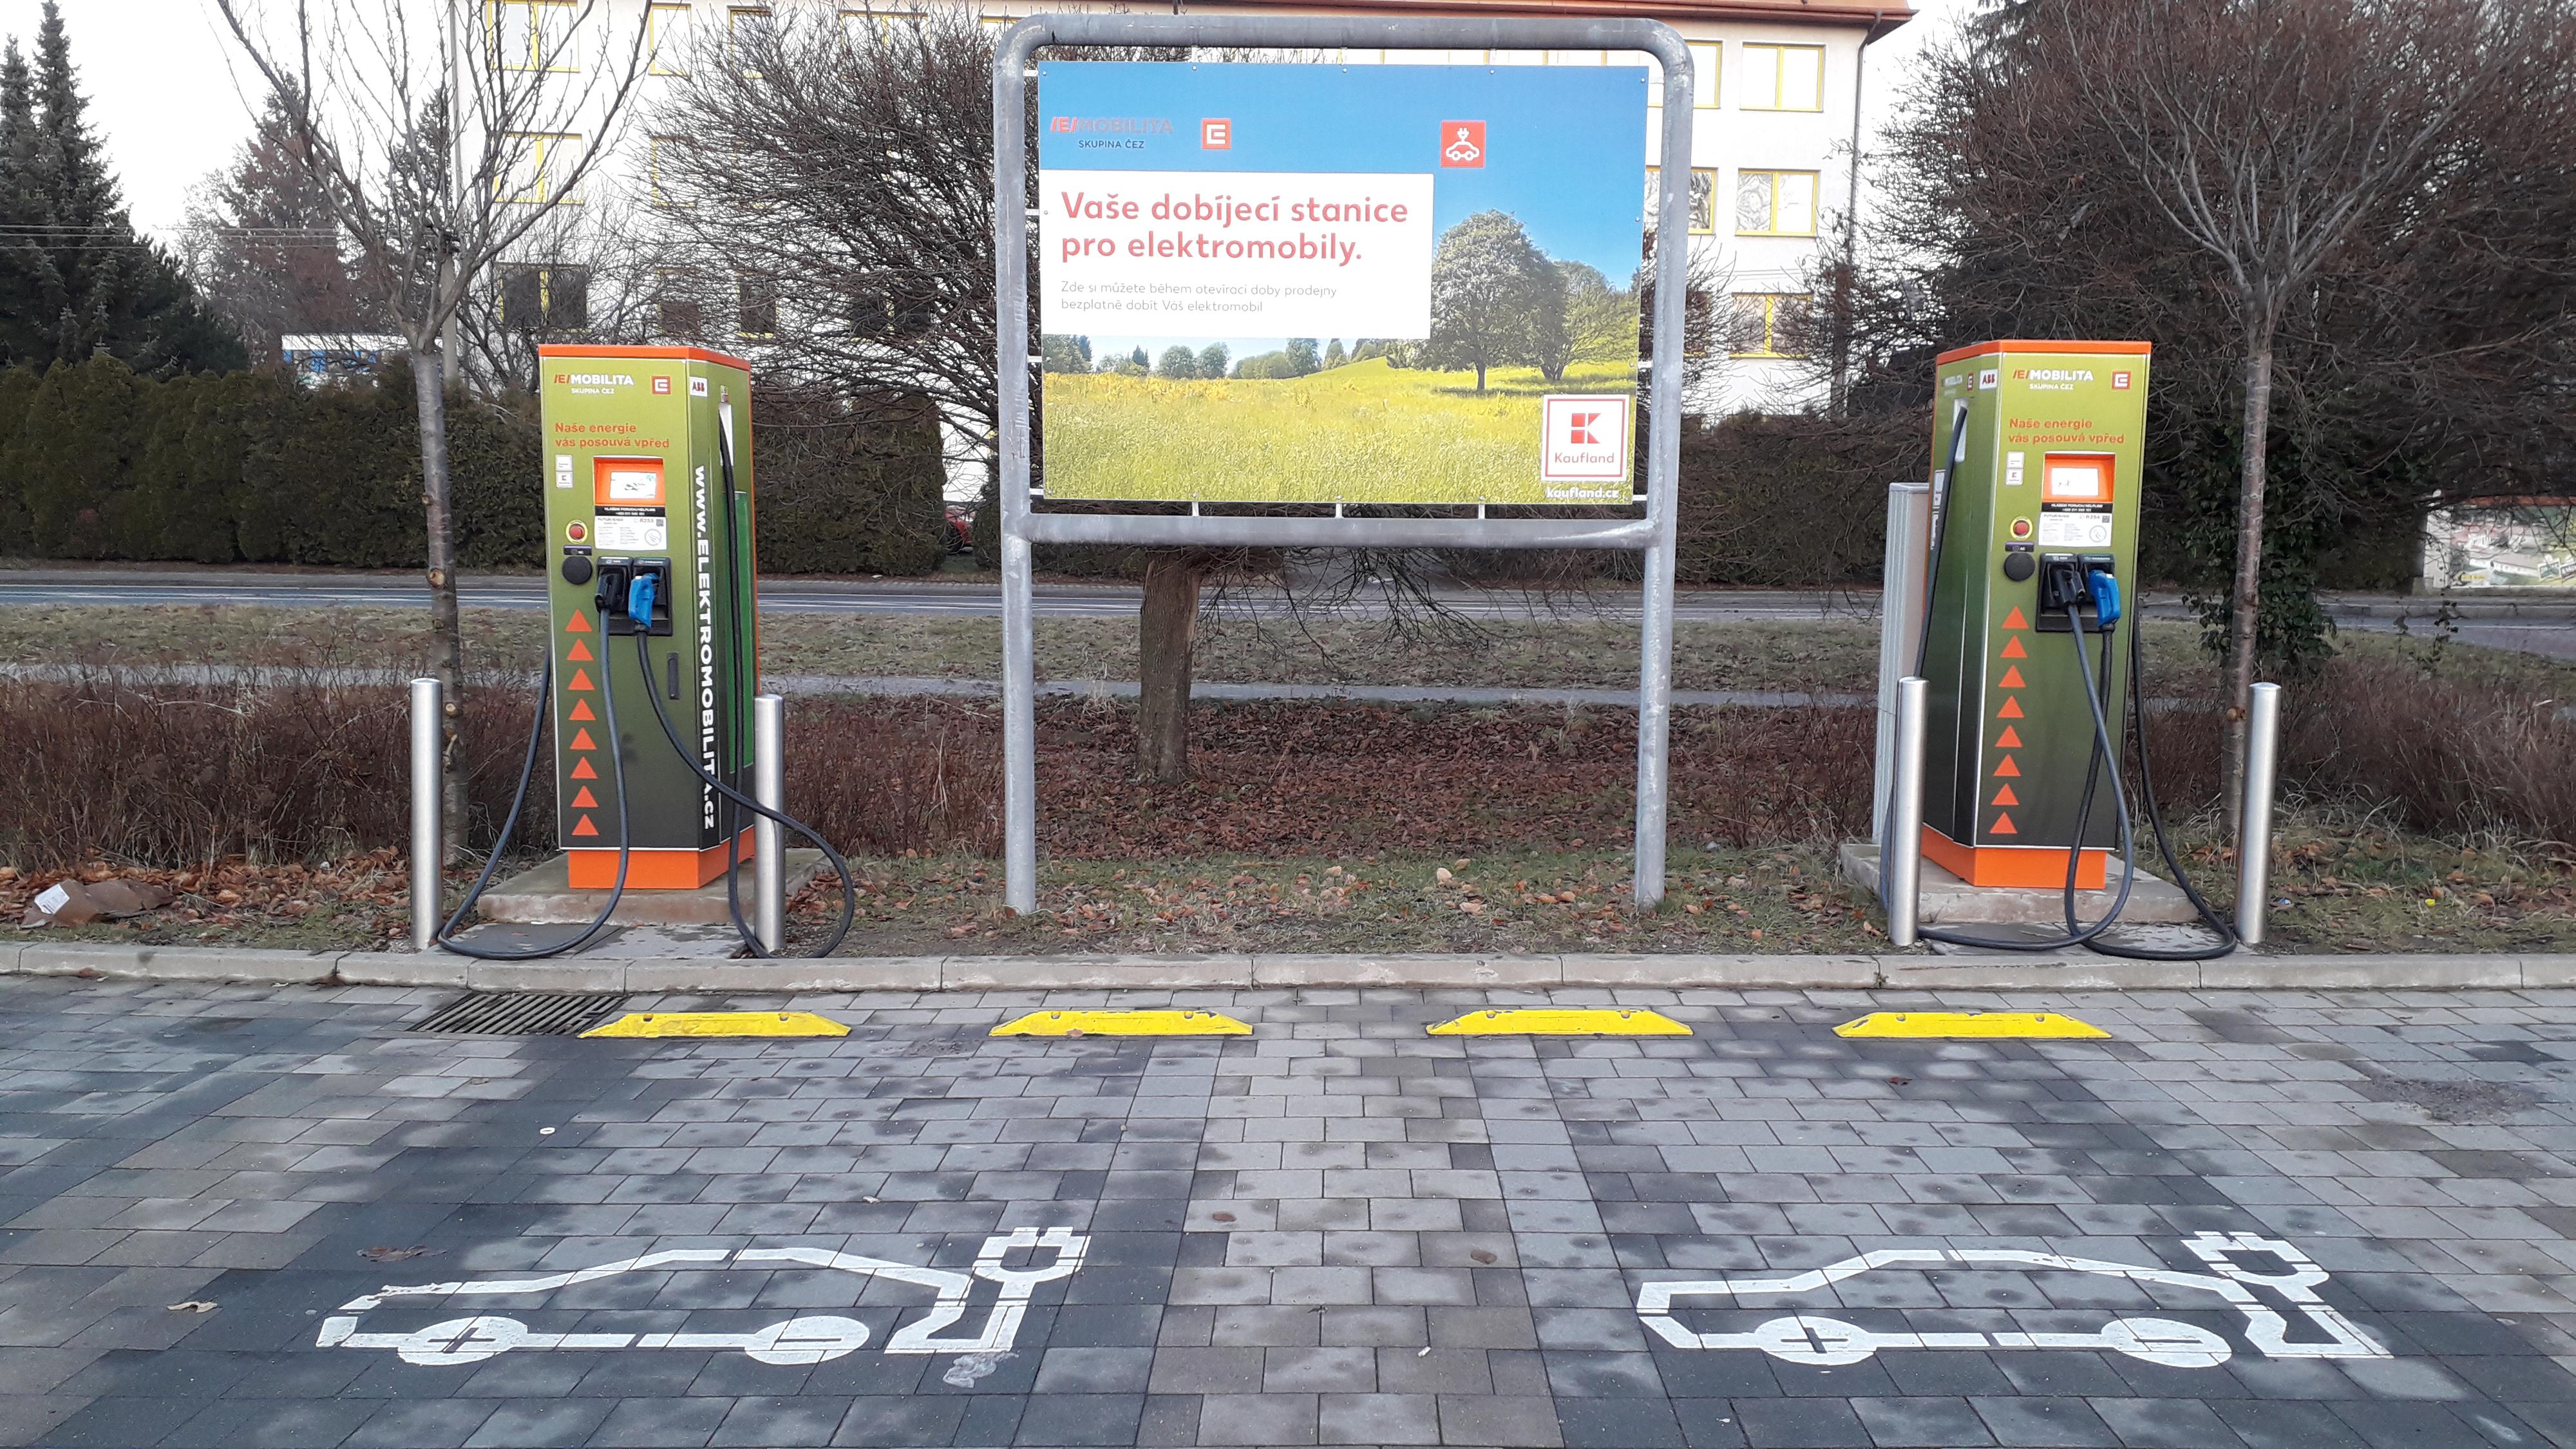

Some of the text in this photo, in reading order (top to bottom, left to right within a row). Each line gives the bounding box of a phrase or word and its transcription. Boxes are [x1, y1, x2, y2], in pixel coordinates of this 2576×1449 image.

[1078, 138, 1145, 149] SKUPINA ČEZ
[1061, 191, 1408, 228] Vaše dobíjecí stanice
[1062, 231, 1362, 267] pro elektromobily.
[1061, 281, 1084, 292] Zde
[1088, 283, 1097, 293] si
[1101, 281, 1146, 294] můžete
[1150, 283, 1191, 294] během
[1251, 284, 1281, 298] doby
[1285, 285, 1337, 298] prodejny
[1061, 298, 1262, 312] bezplatně dobít Váš elektromobil
[1982, 374, 1995, 385] ABB
[601, 386, 615, 395] ČEZ
[692, 381, 705, 392] ABB
[555, 422, 637, 434] Naše energie
[2009, 418, 2092, 430] Naše energie
[555, 437, 670, 450] vás posouvá vpřed
[2009, 433, 2125, 444] vás posouvá vpřed
[1554, 452, 1615, 464] Kaufland
[1546, 487, 1620, 498] kaufland.cz
